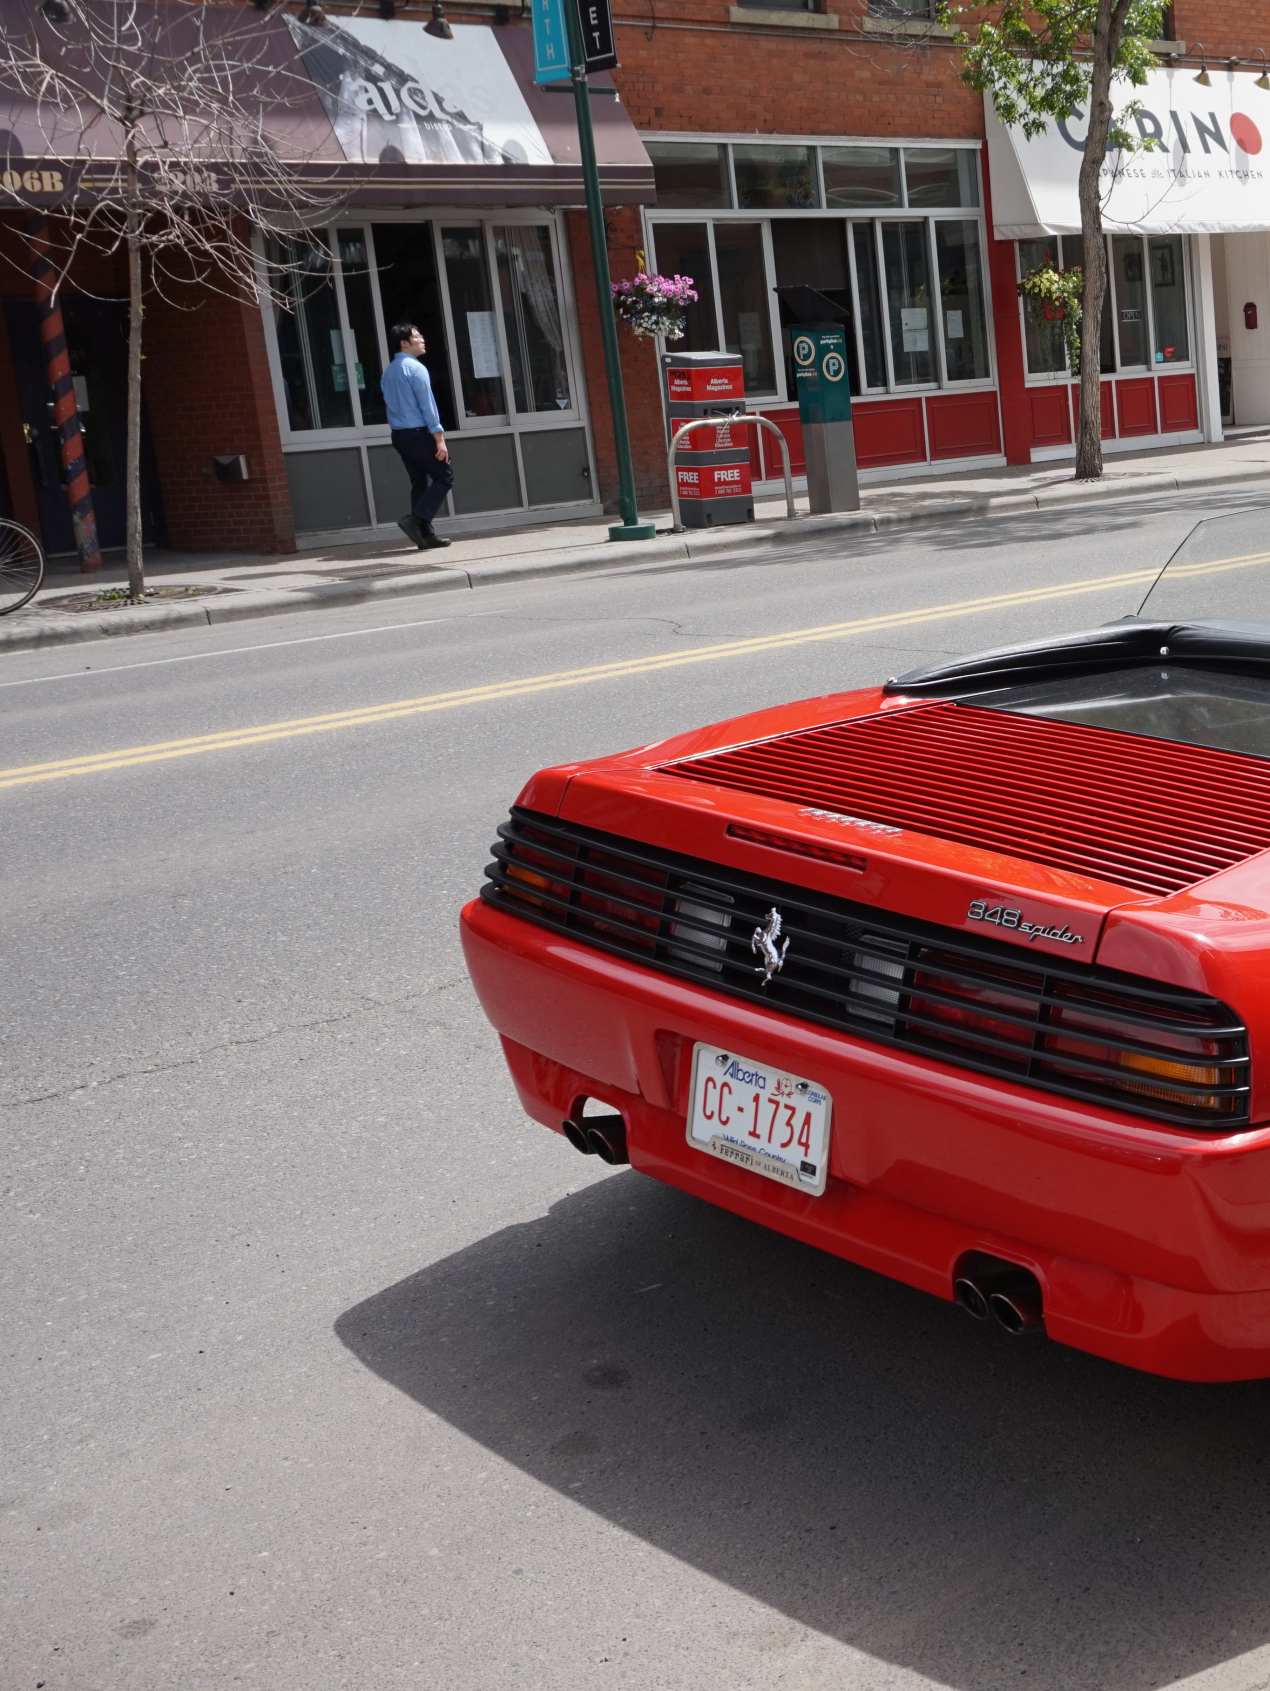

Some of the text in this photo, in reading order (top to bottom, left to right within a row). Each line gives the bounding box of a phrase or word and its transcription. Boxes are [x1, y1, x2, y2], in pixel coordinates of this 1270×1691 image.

[1167, 168, 1211, 179] ITALIAN
[1217, 169, 1264, 179] KITCHEN
[1123, 311, 1141, 320] OPEN
[678, 472, 699, 483] FREE
[714, 469, 741, 482] FREE
[967, 900, 1084, 943] 348 spider
[723, 1060, 767, 1090] Alberta
[702, 1076, 812, 1158] CC-1734
[720, 1144, 754, 1166] Ferrari
[762, 1163, 794, 1181] ALBERTA
